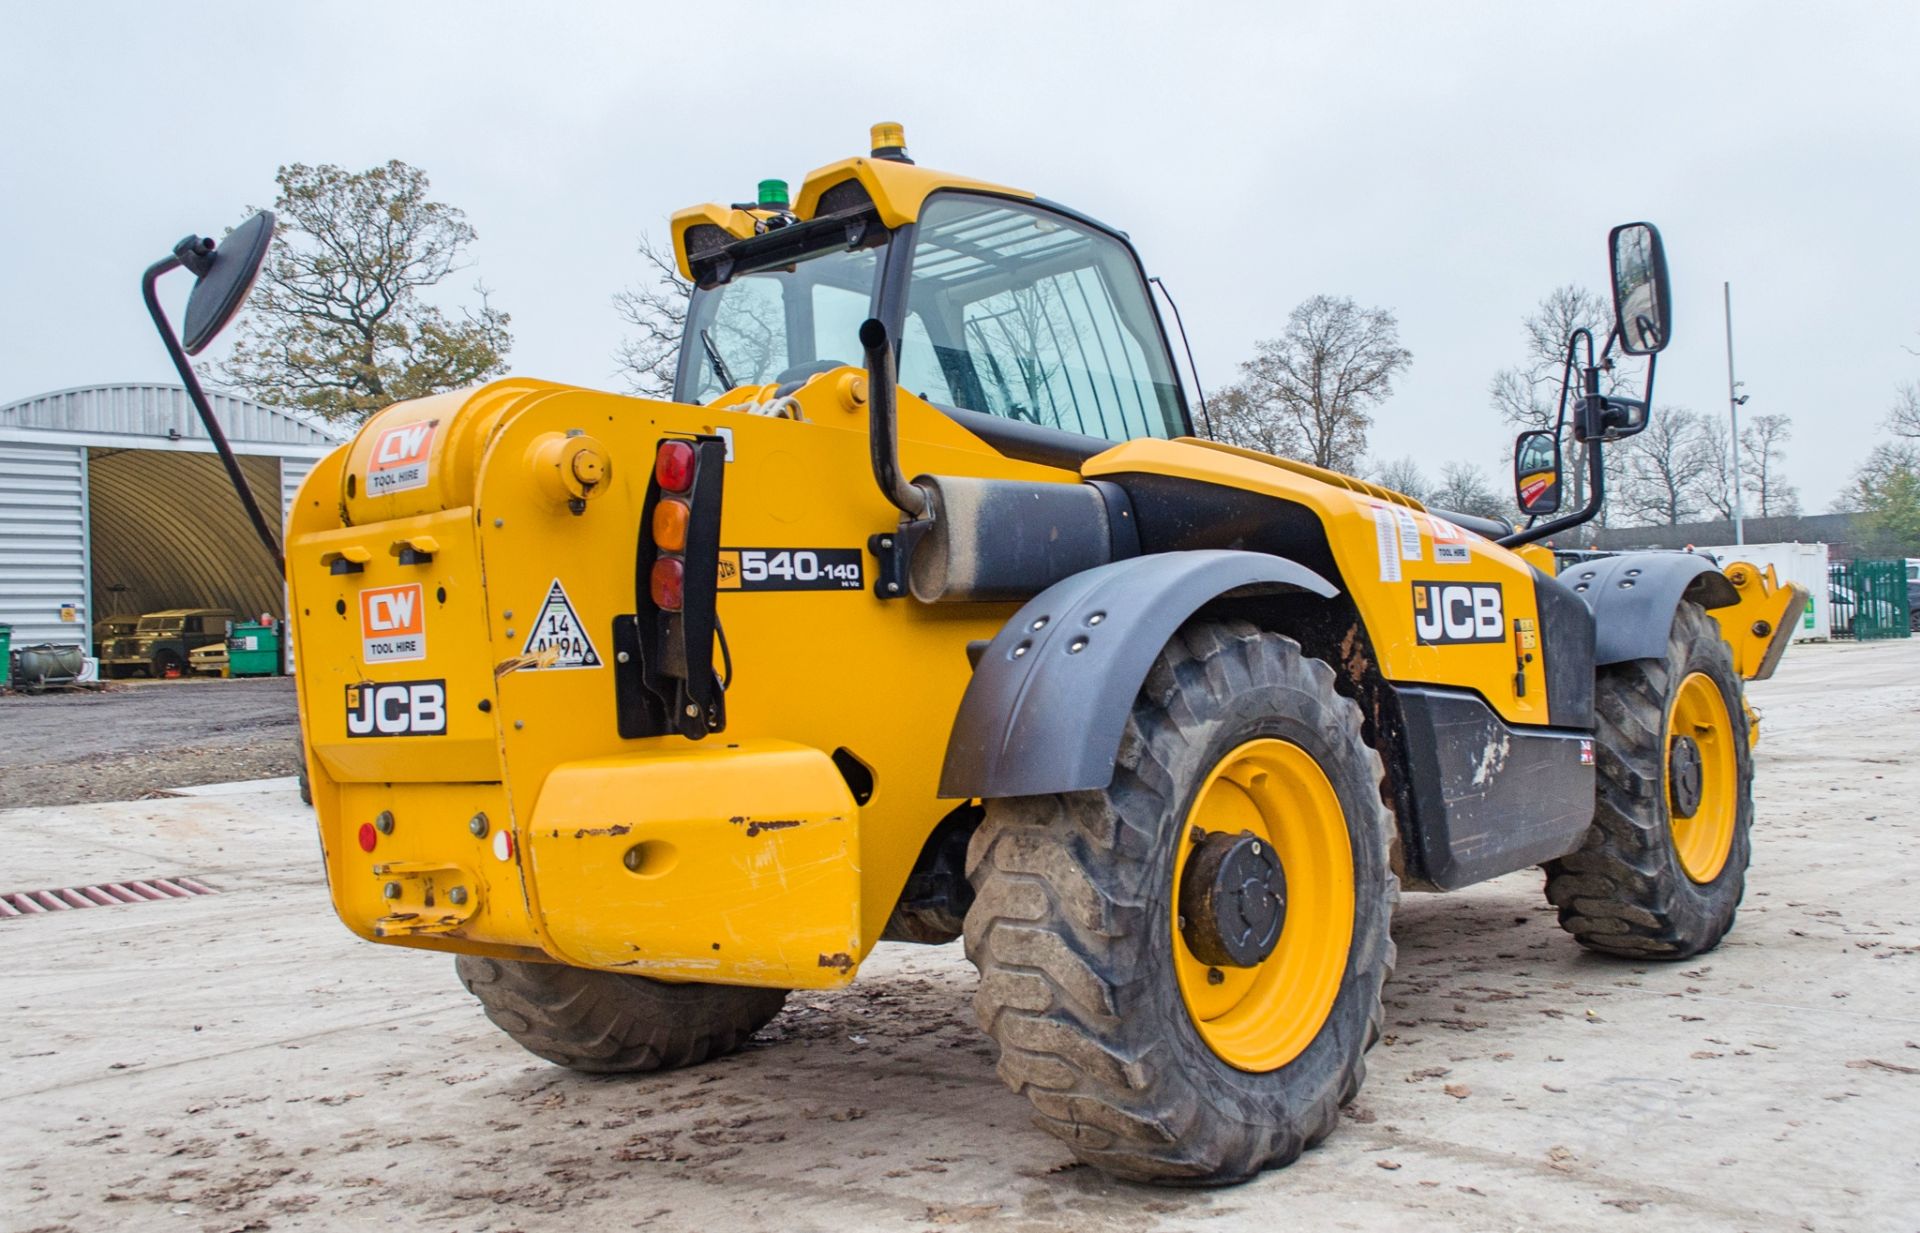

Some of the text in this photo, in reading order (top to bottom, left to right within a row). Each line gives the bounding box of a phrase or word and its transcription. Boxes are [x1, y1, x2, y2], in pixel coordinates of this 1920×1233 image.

[378, 426, 430, 464] CW
[374, 469, 419, 487] TOOL HIRE
[741, 551, 859, 581] 540-140
[1438, 548, 1466, 557] TOOL HIRE
[369, 590, 416, 630] CW
[548, 615, 569, 635] 14
[1416, 586, 1504, 640] JCB
[371, 640, 417, 655] TOOL HIRE
[347, 684, 446, 734] JCB
